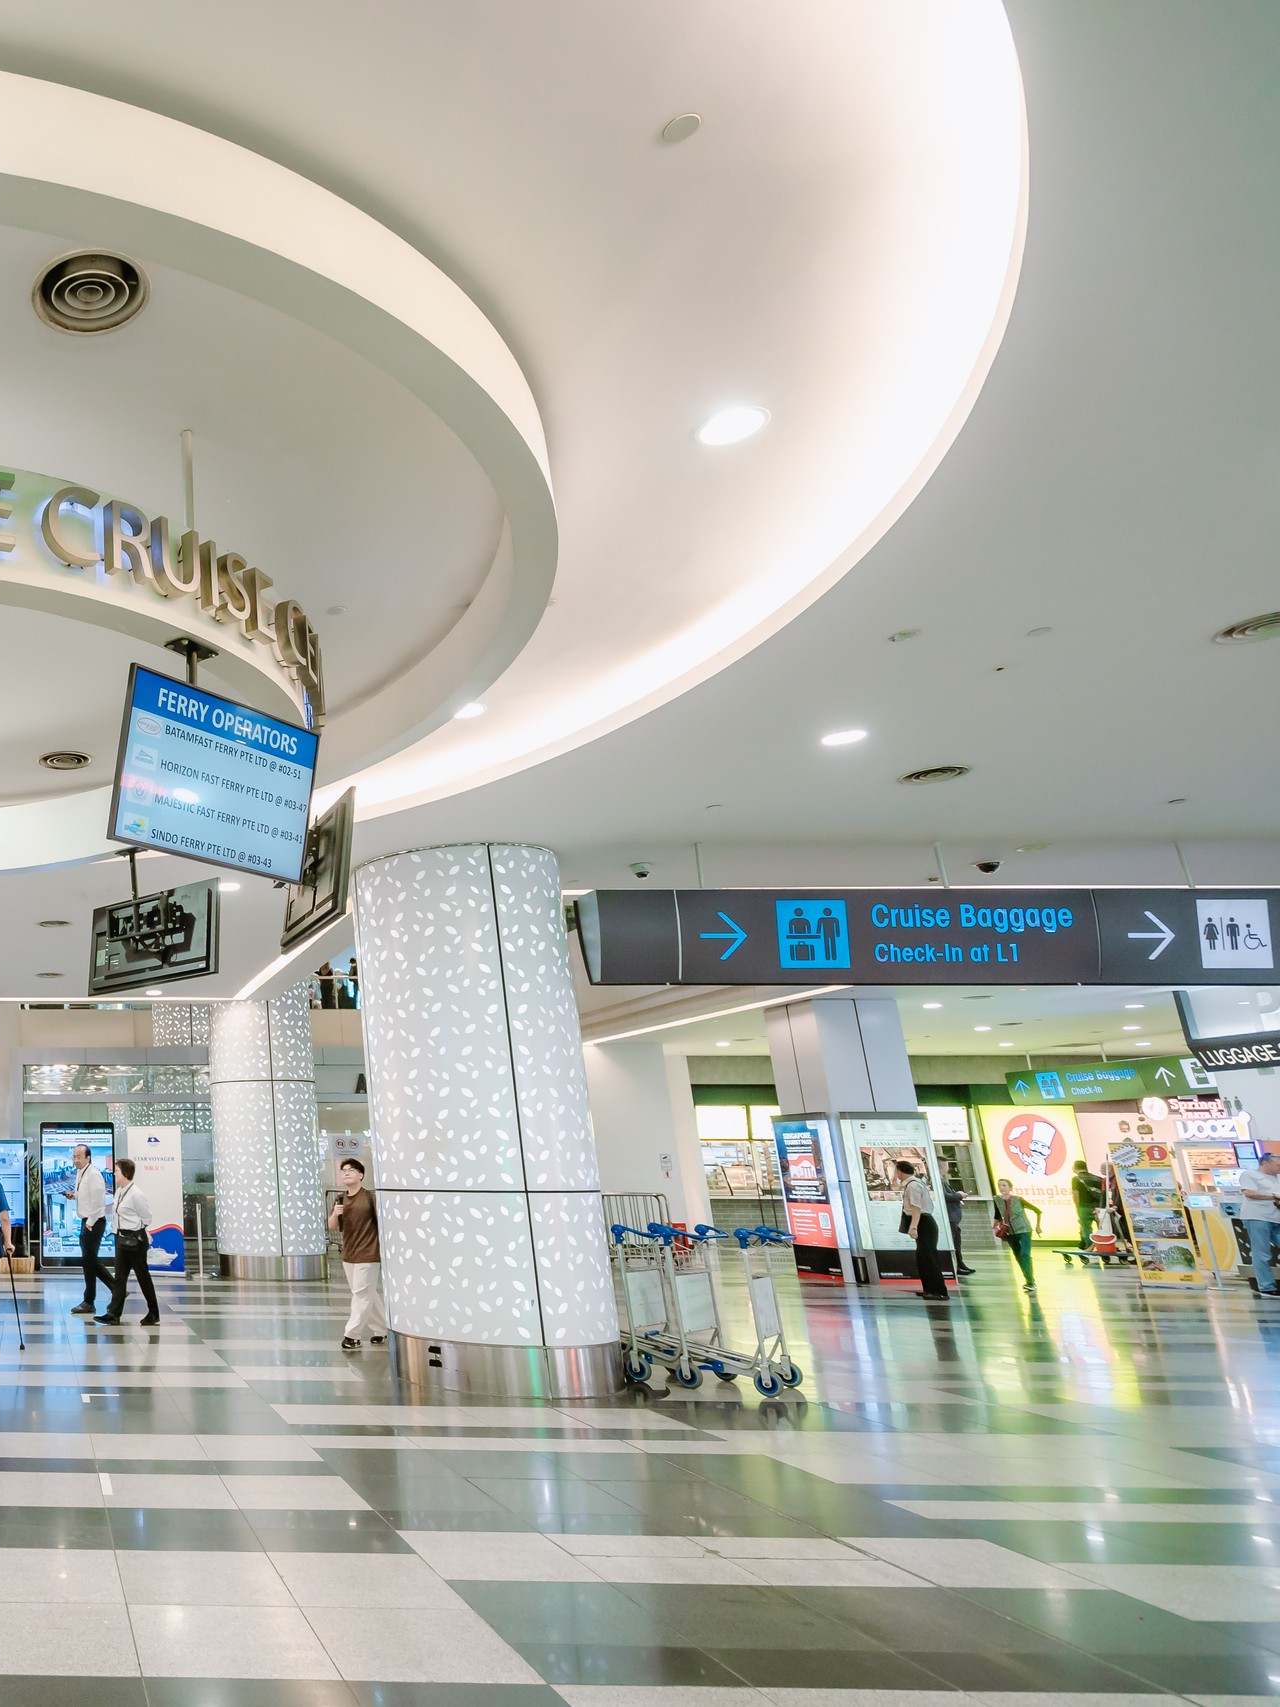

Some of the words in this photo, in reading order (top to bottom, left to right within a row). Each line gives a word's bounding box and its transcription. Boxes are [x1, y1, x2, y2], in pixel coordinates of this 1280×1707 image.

[40, 486, 277, 645] CRUISE
[157, 687, 210, 723] FERRY
[212, 708, 298, 755] OPERATORS
[165, 725, 213, 749] BATAMFAST
[214, 743, 239, 758] FERRY
[240, 751, 253, 764] PTE
[255, 756, 268, 768] LTD
[269, 761, 277, 772] @
[278, 764, 302, 780] #02-51
[160, 759, 199, 780] HORIZON
[201, 772, 220, 786] FAST
[221, 778, 245, 795] FERRY
[246, 787, 260, 799] PTE
[261, 791, 274, 803] LTD
[275, 795, 283, 807] @
[284, 799, 307, 813] #03-47
[154, 793, 195, 814] MAJESTIC
[196, 806, 215, 820] FAST
[217, 811, 241, 827] FERRY
[242, 819, 256, 831] PTE
[257, 823, 270, 835] LTD
[271, 827, 279, 839] @
[280, 830, 303, 844] #03-41
[151, 828, 178, 845] SINDO
[180, 836, 206, 851] FERRY
[207, 843, 221, 855] PTE
[222, 847, 236, 859] LTD
[237, 851, 246, 863] @
[247, 854, 272, 868] #03-43
[871, 903, 950, 928] Cruise
[960, 903, 1073, 933] Baggage
[874, 943, 963, 963] Check-In
[970, 944, 990, 963] at
[996, 943, 1019, 962] L1
[1198, 1044, 1280, 1066] LUGGAGE
[1065, 1071, 1094, 1083] Cruise
[1096, 1068, 1136, 1082] Baggage
[1070, 1086, 1103, 1096] Check-In
[1168, 1098, 1225, 1112] Springl
[1009, 1185, 1073, 1198] pringlea
